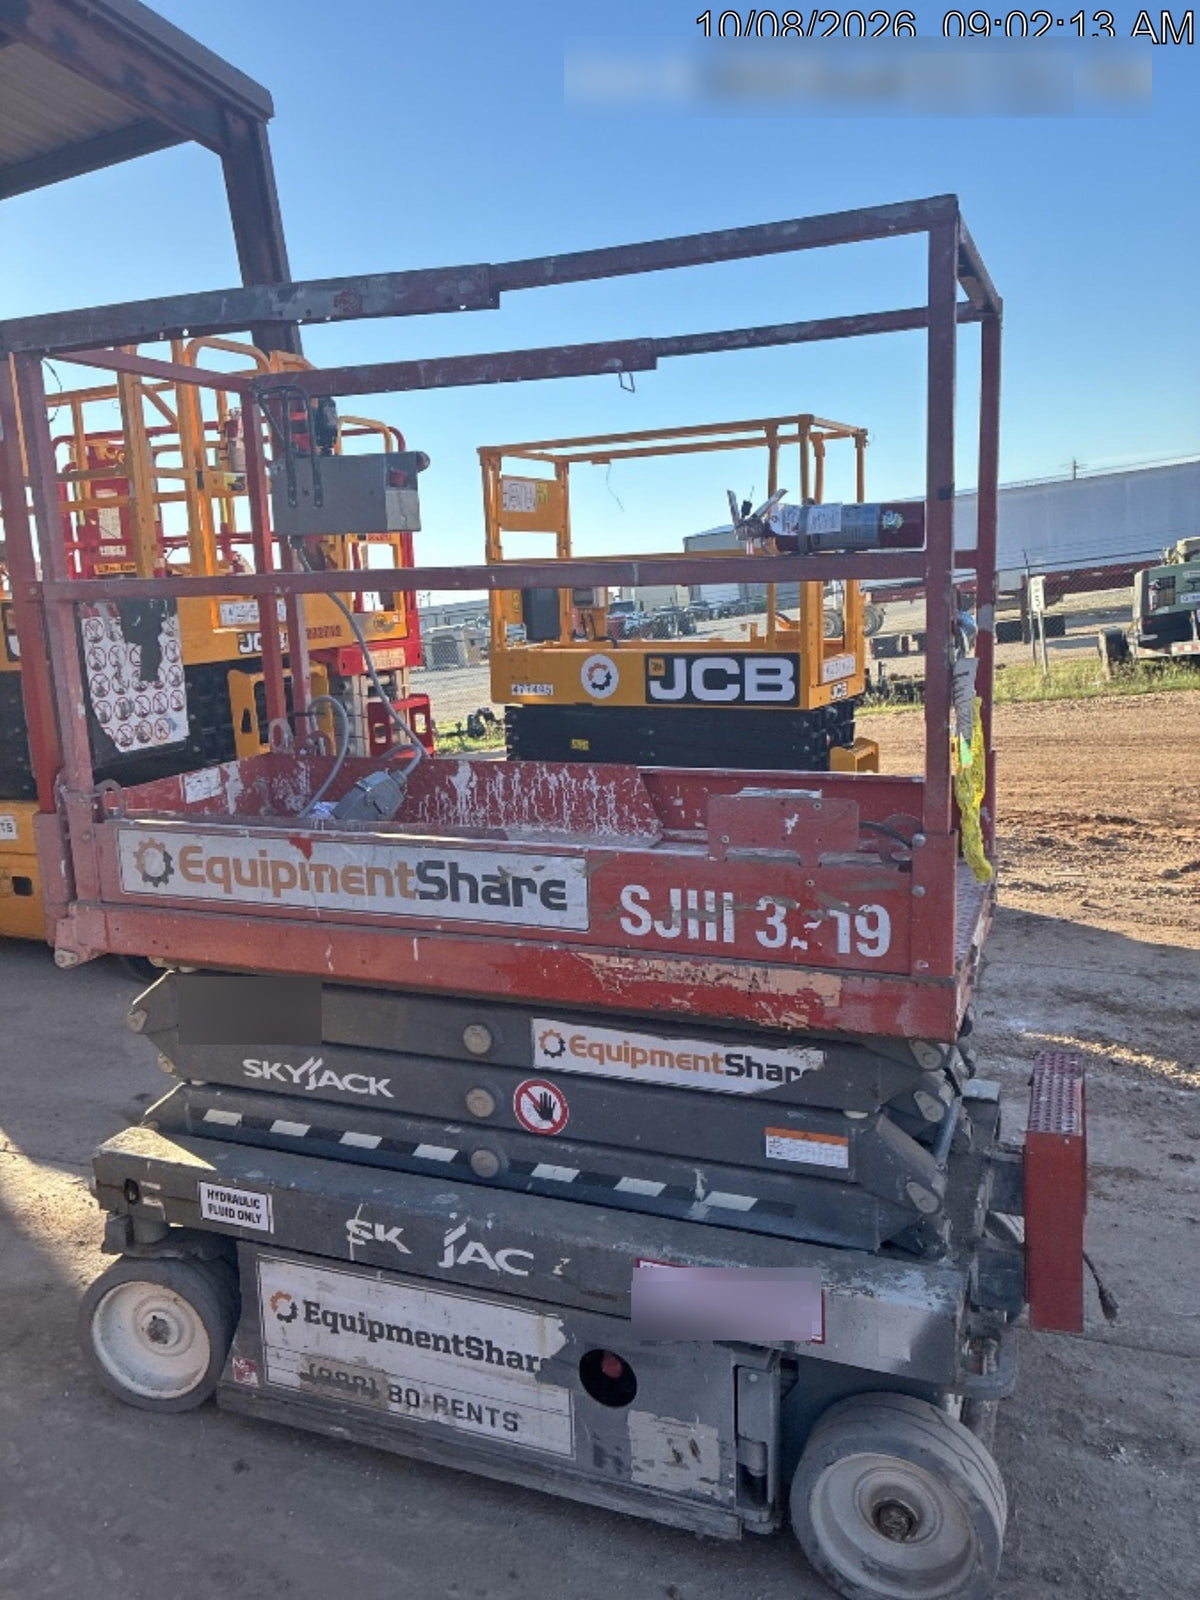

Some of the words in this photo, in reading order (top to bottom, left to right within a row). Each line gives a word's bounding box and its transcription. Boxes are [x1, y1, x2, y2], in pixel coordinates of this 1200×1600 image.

[649, 657, 796, 702] JCB
[178, 846, 568, 911] EquipmentShare
[755, 895, 892, 958] 319
[242, 1056, 395, 1098] SKYJACK
[568, 1033, 812, 1084] EquipmentShar
[207, 1188, 260, 1209] HYDRAULIC
[208, 1203, 235, 1218] FLUID
[238, 1209, 262, 1224] ONLY
